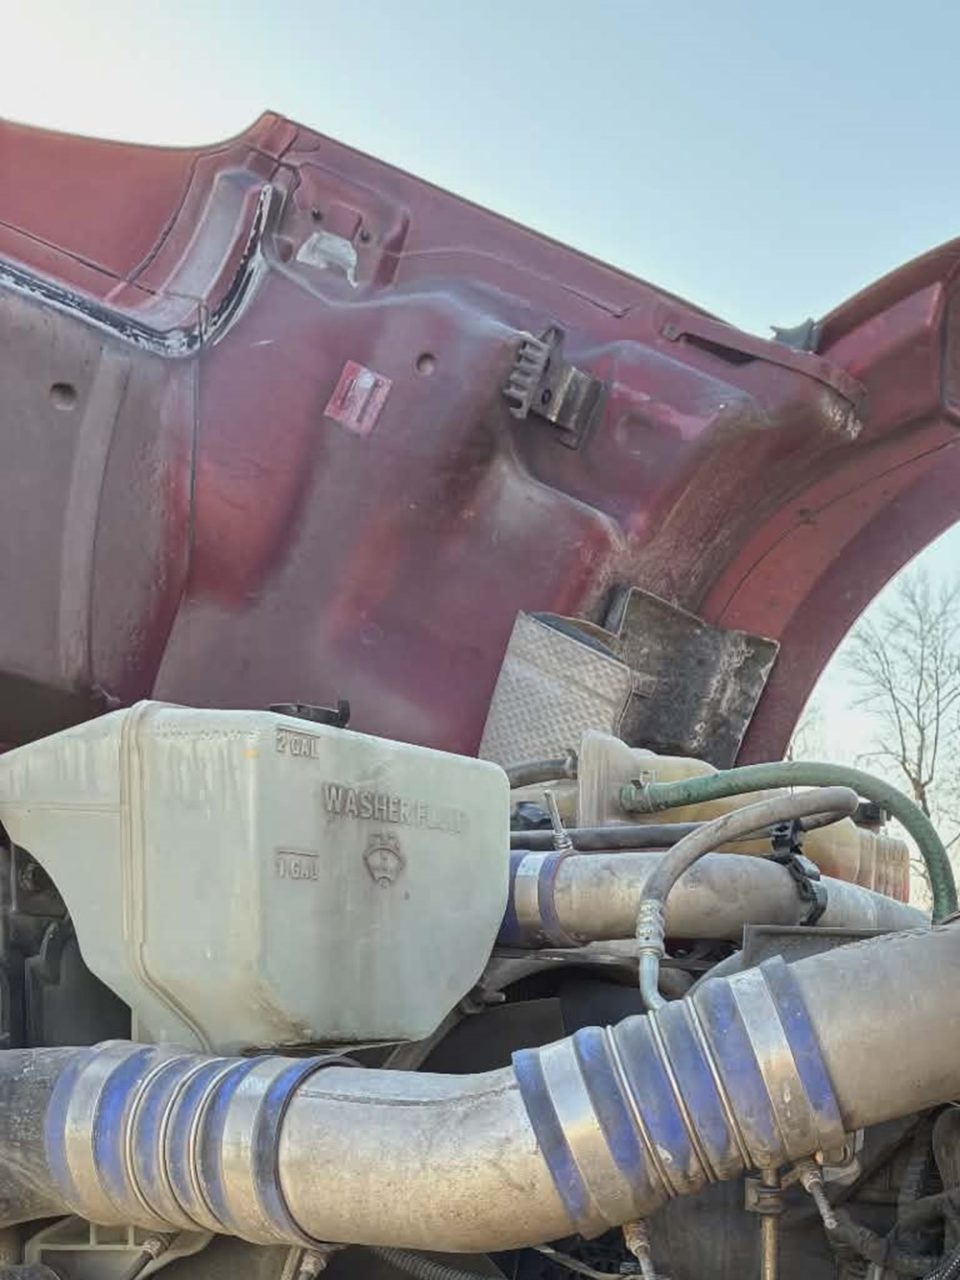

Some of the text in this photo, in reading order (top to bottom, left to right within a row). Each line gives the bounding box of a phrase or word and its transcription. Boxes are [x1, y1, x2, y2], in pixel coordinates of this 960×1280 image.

[276, 731, 320, 760] 2 GAL
[323, 784, 411, 824] WASHER
[290, 860, 320, 882] GAL
